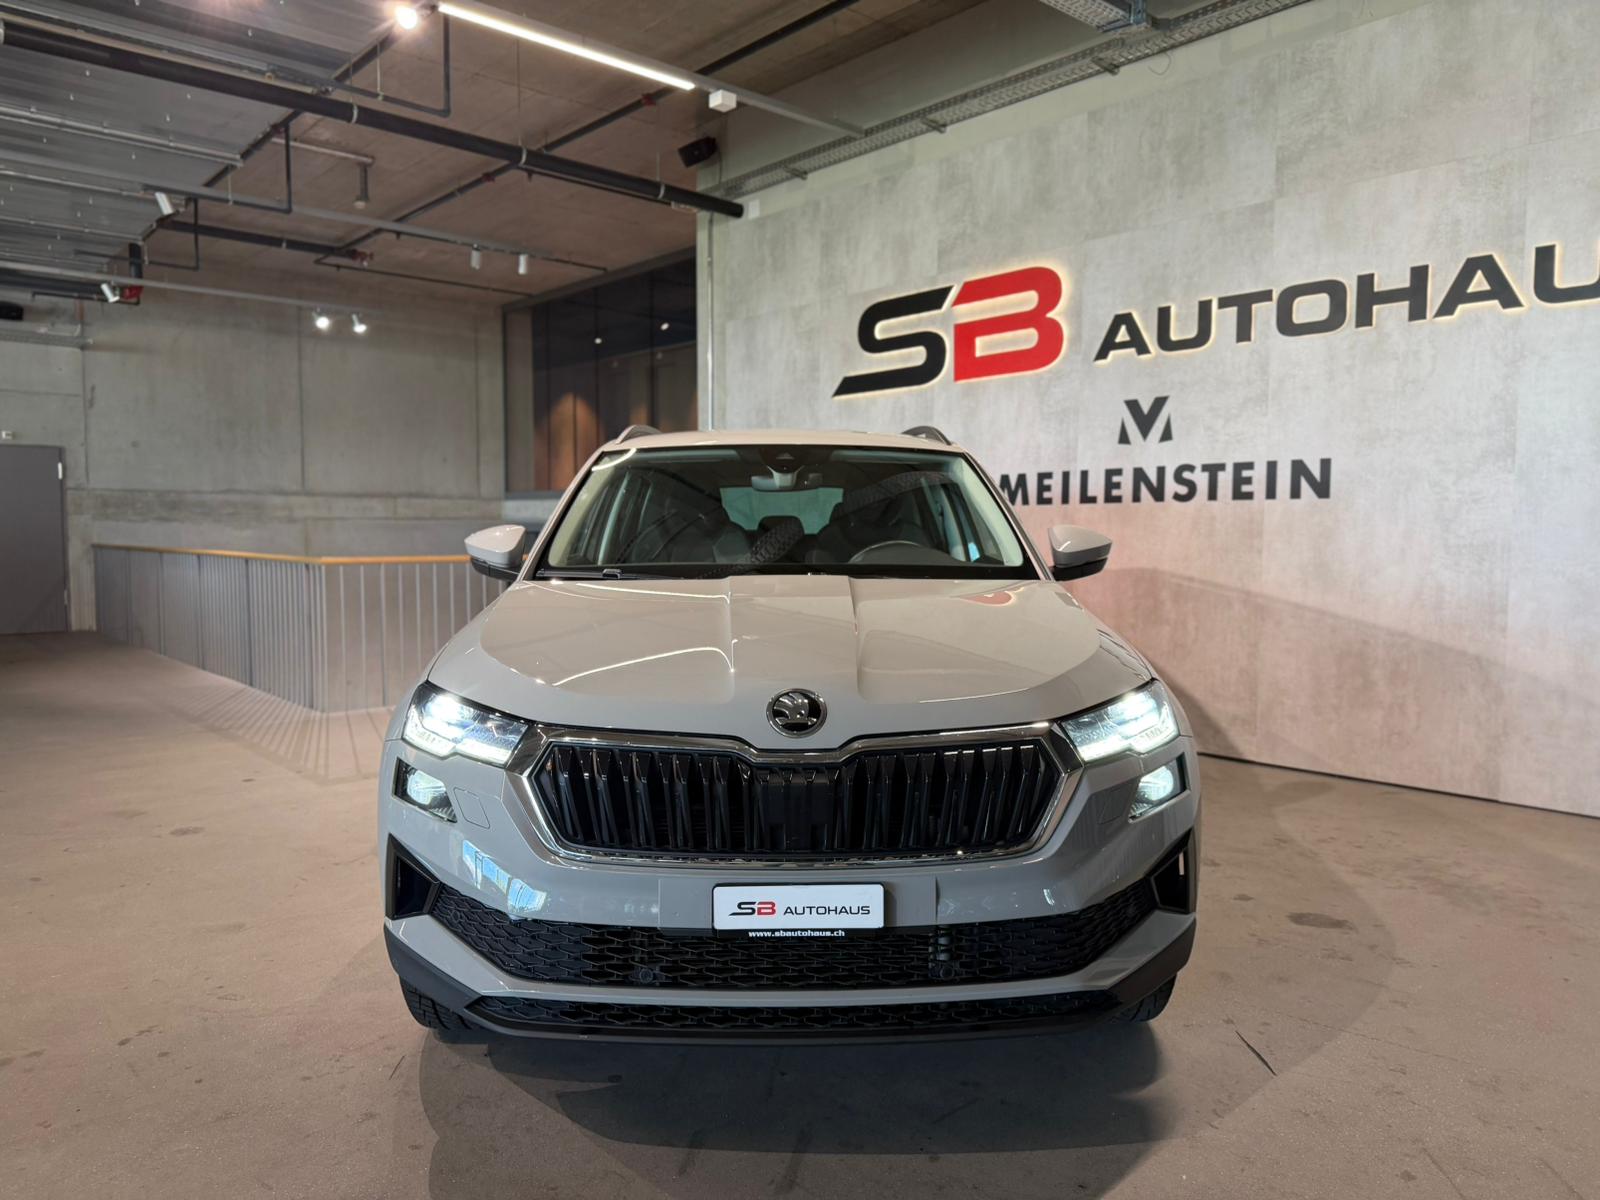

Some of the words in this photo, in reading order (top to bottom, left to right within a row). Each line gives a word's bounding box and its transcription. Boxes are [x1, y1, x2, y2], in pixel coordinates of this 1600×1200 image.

[832, 266, 1064, 398] SB
[999, 457, 1332, 506] MEILENSTEIN
[728, 901, 777, 916] SB
[783, 905, 871, 916] AUTOHAUS
[748, 929, 845, 938] www.sbautohaus.ch
